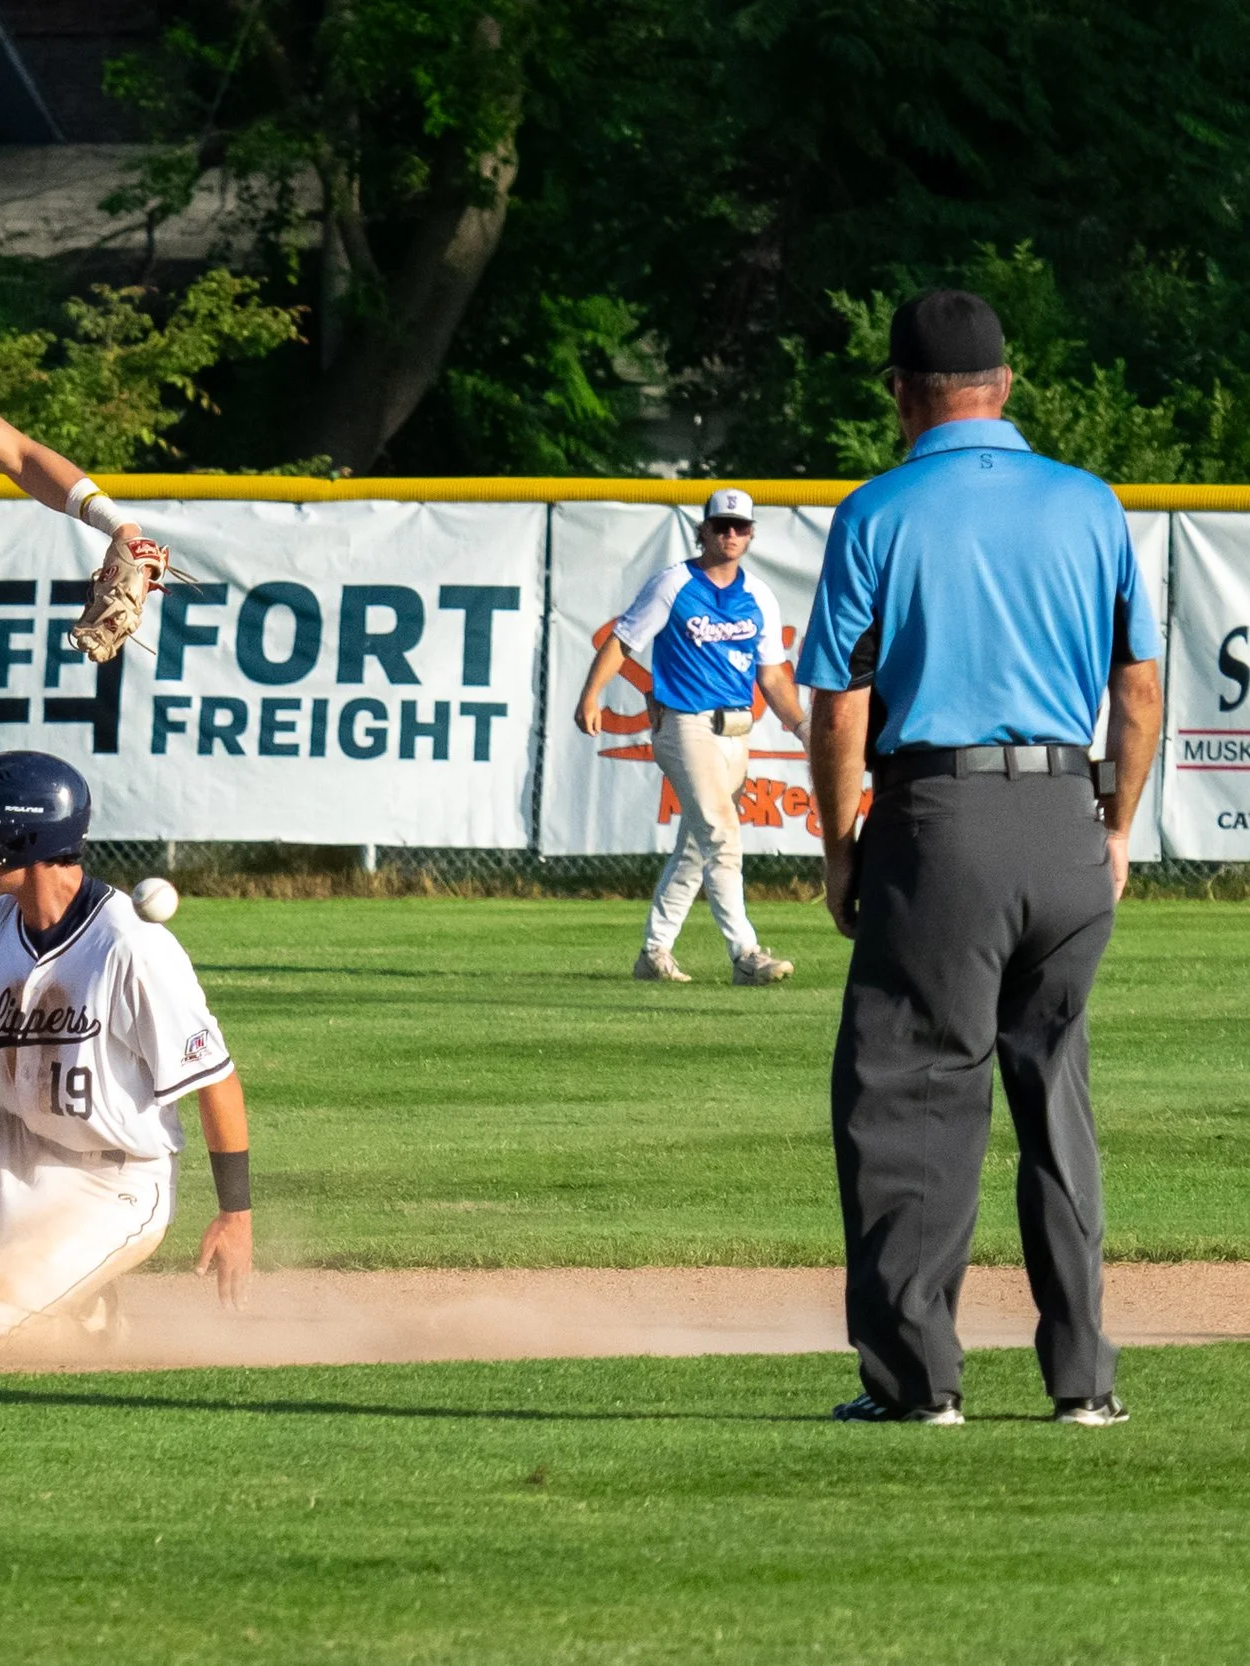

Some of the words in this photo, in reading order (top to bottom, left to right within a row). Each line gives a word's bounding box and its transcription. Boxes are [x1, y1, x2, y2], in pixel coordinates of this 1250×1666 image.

[155, 581, 521, 687] FORT
[150, 695, 509, 762] FREIGHT
[1218, 812, 1250, 829] CA
[50, 1060, 93, 1121] 19
